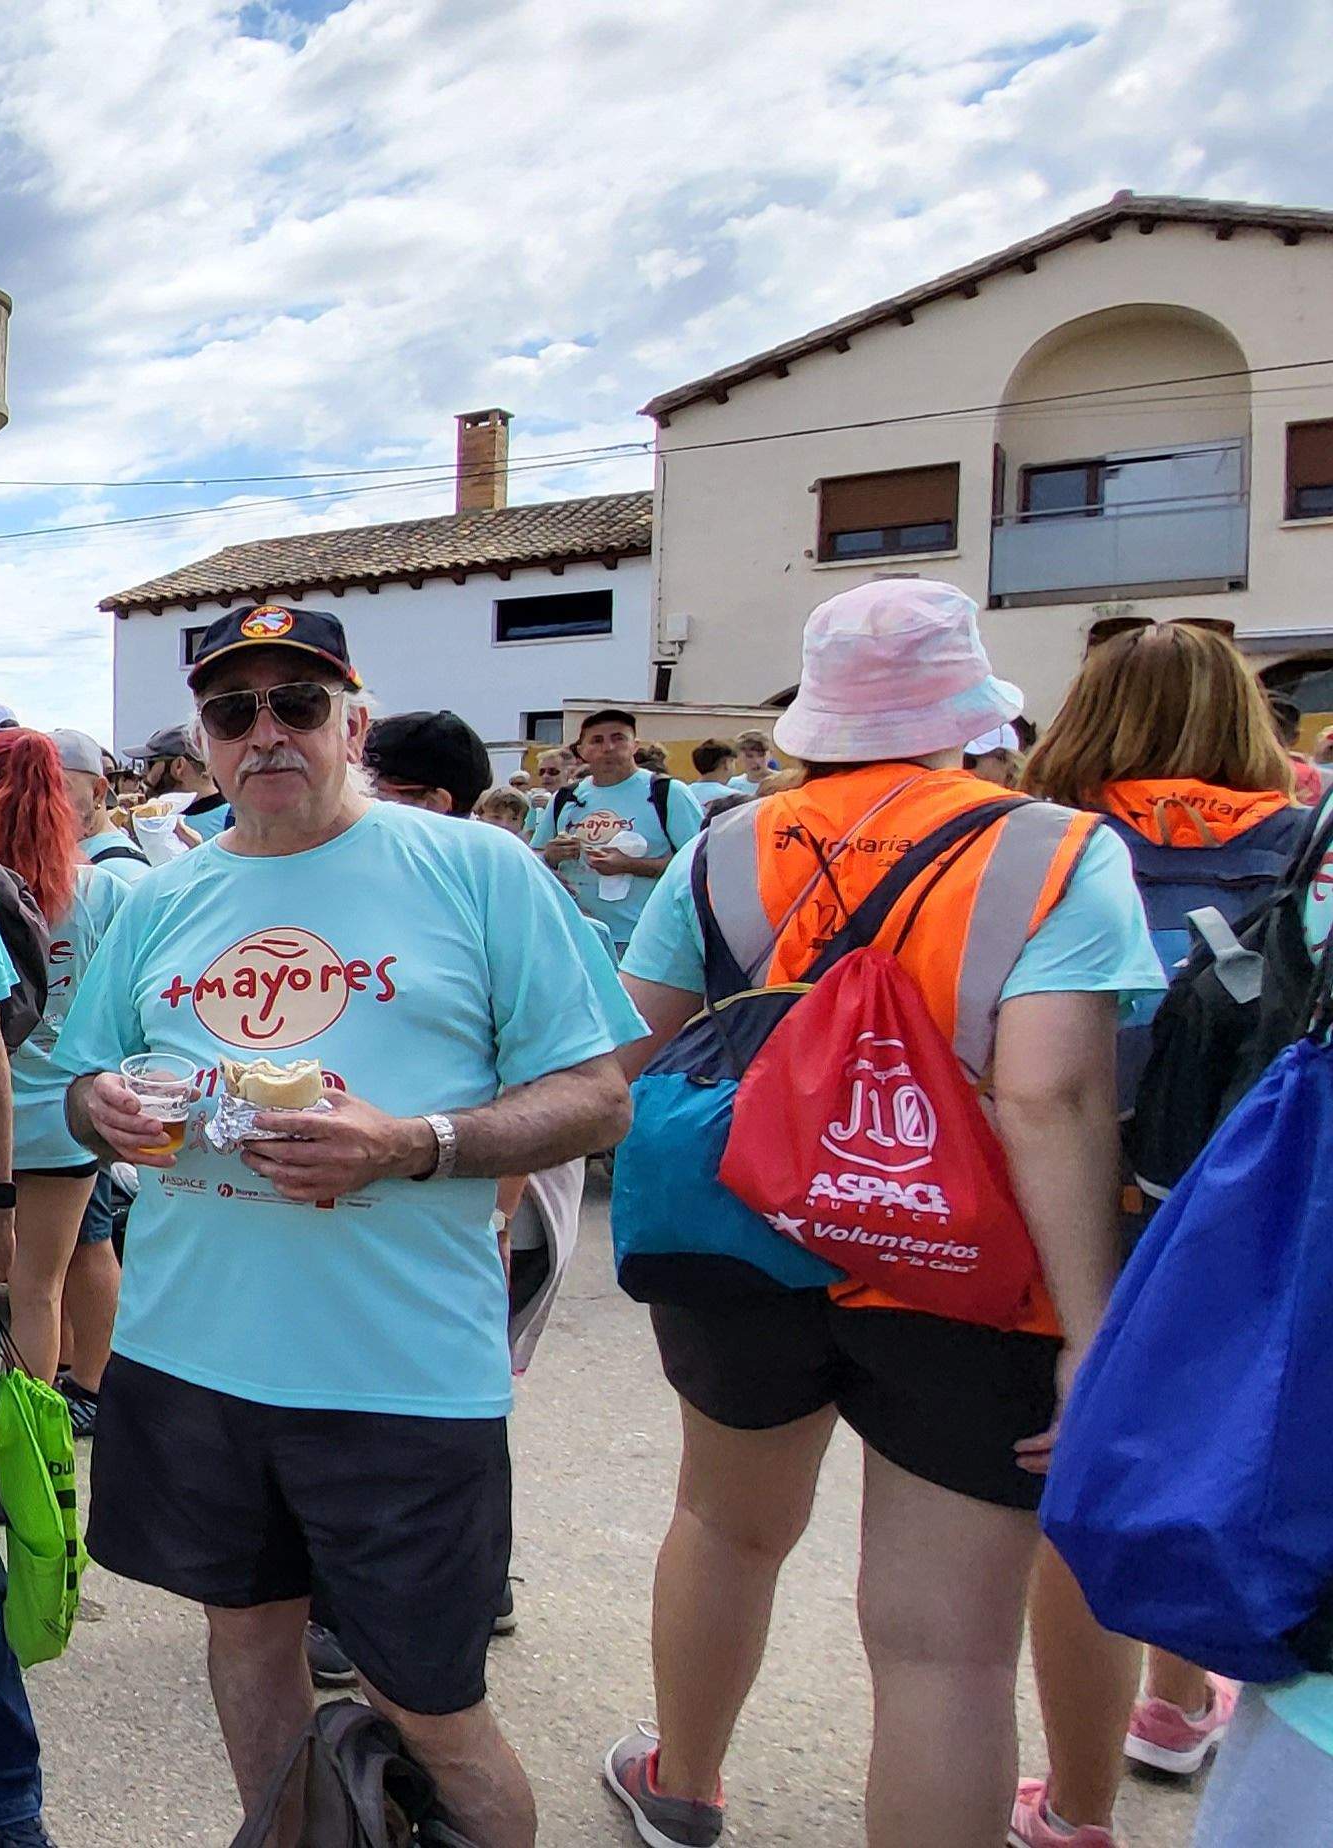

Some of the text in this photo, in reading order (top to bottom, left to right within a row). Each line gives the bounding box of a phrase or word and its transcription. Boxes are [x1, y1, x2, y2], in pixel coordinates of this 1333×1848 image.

[566, 816, 636, 836] +mayores
[160, 955, 397, 1021] +mayores
[809, 1173, 951, 1215] ASPACE
[805, 1197, 948, 1225] HUESCA
[814, 1222, 981, 1260] Voluntarios
[879, 1251, 899, 1262] de
